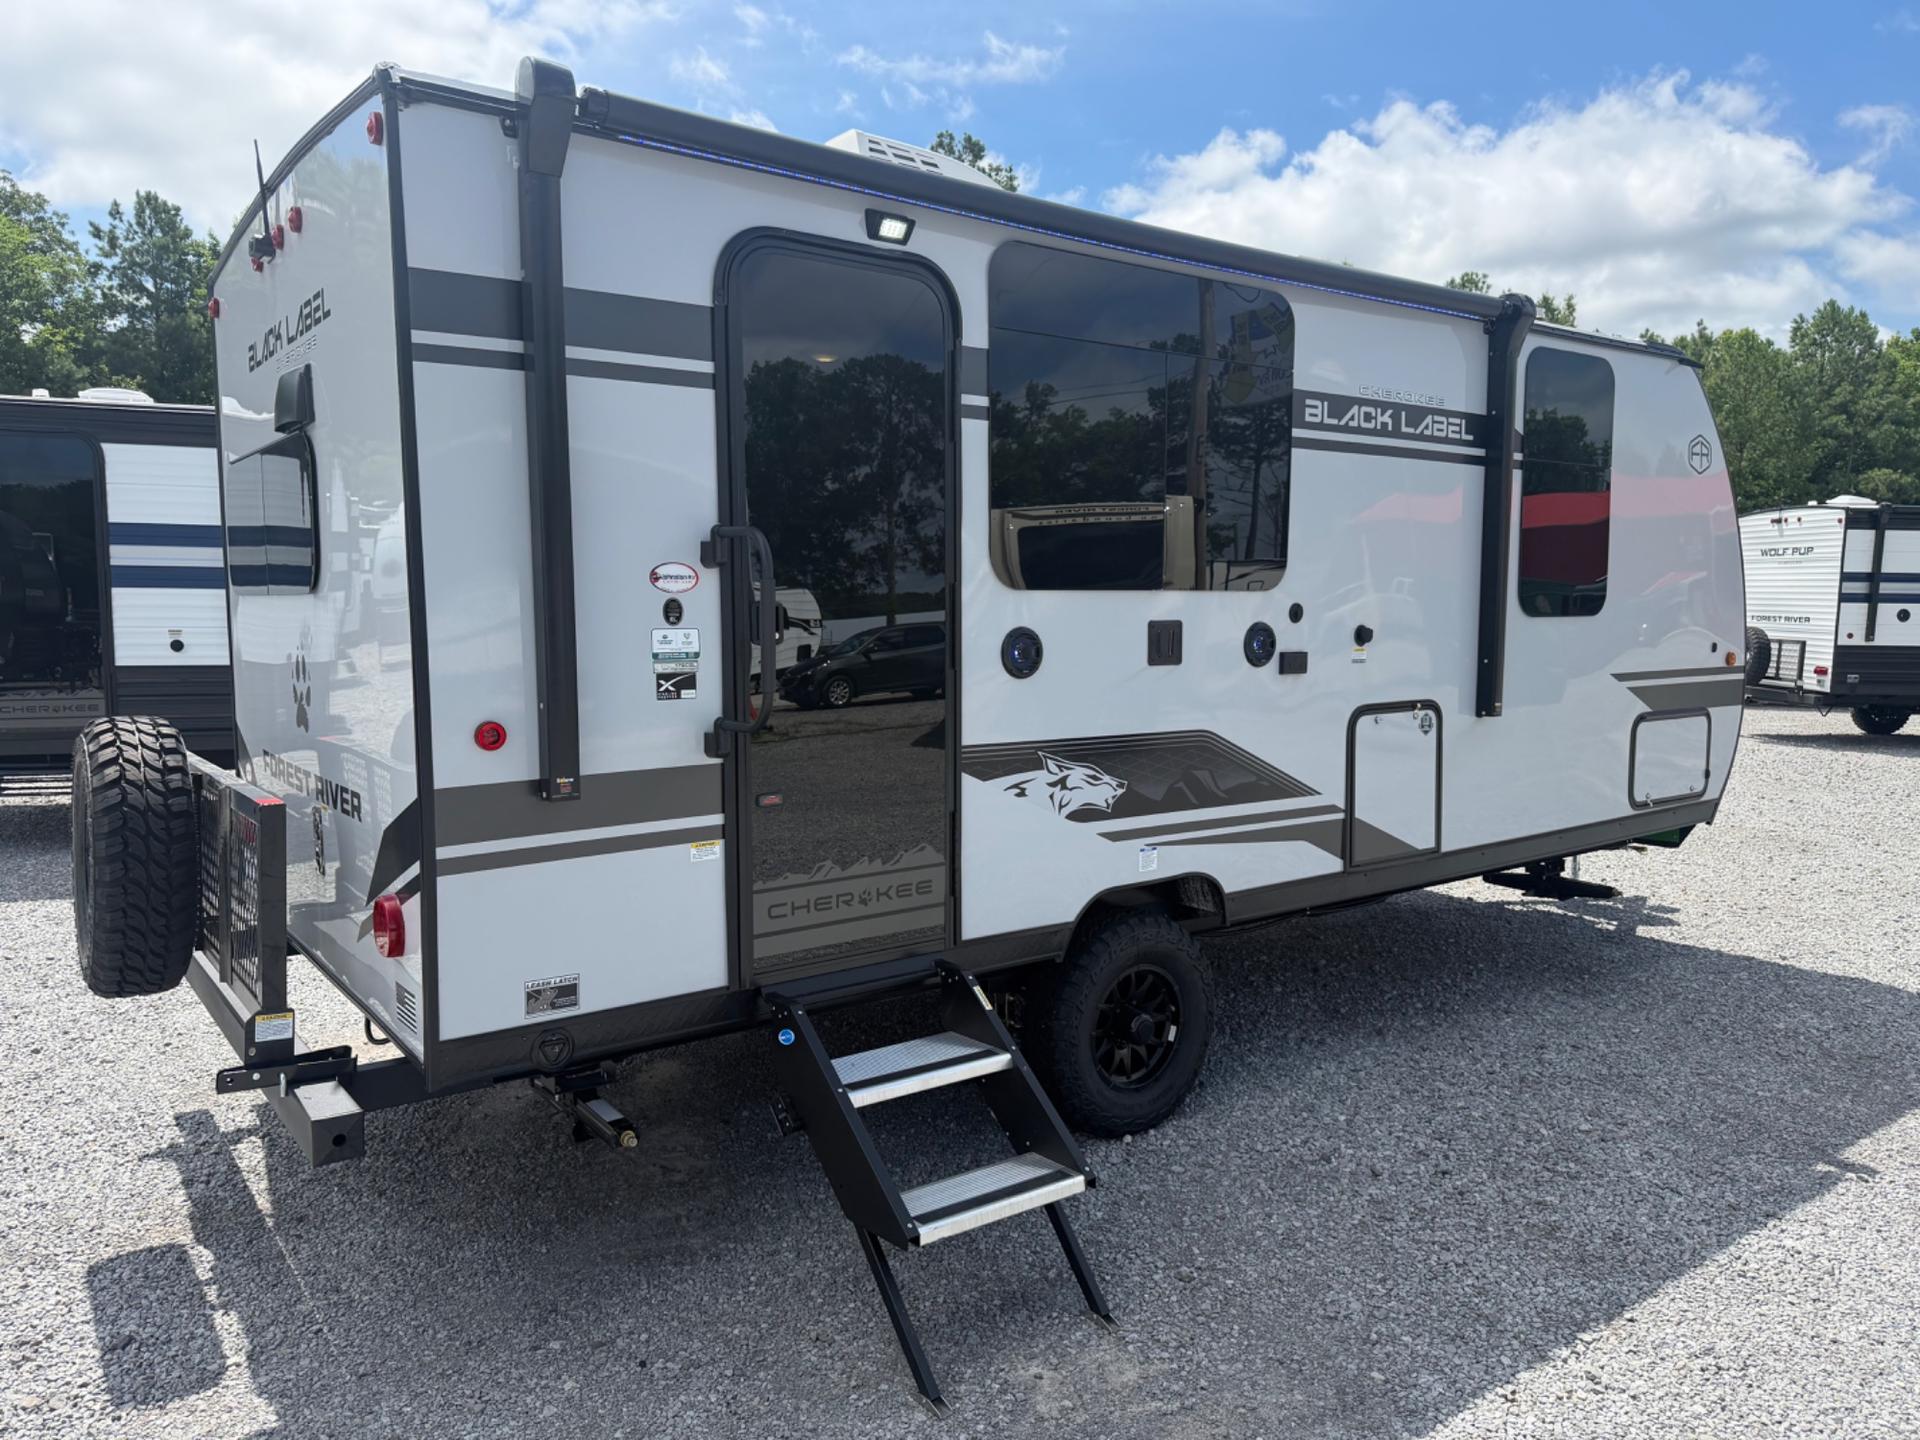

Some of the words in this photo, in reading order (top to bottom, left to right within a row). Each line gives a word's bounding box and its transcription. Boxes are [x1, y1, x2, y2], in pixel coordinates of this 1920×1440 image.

[248, 319, 283, 373] BLACK
[286, 287, 331, 346] LABEL
[1358, 384, 1446, 407] CHEROKEE
[1304, 398, 1394, 432] BLACK
[1401, 411, 1475, 441] LABEL
[1760, 547, 1790, 557] WOLF
[1791, 546, 1814, 556] PUP
[1751, 615, 1783, 623] FOREST
[1784, 615, 1811, 623] RIVER
[262, 748, 311, 797] FOREST
[314, 774, 362, 823] RIVER
[526, 980, 552, 990] LEASH
[553, 976, 578, 986] LATCH
